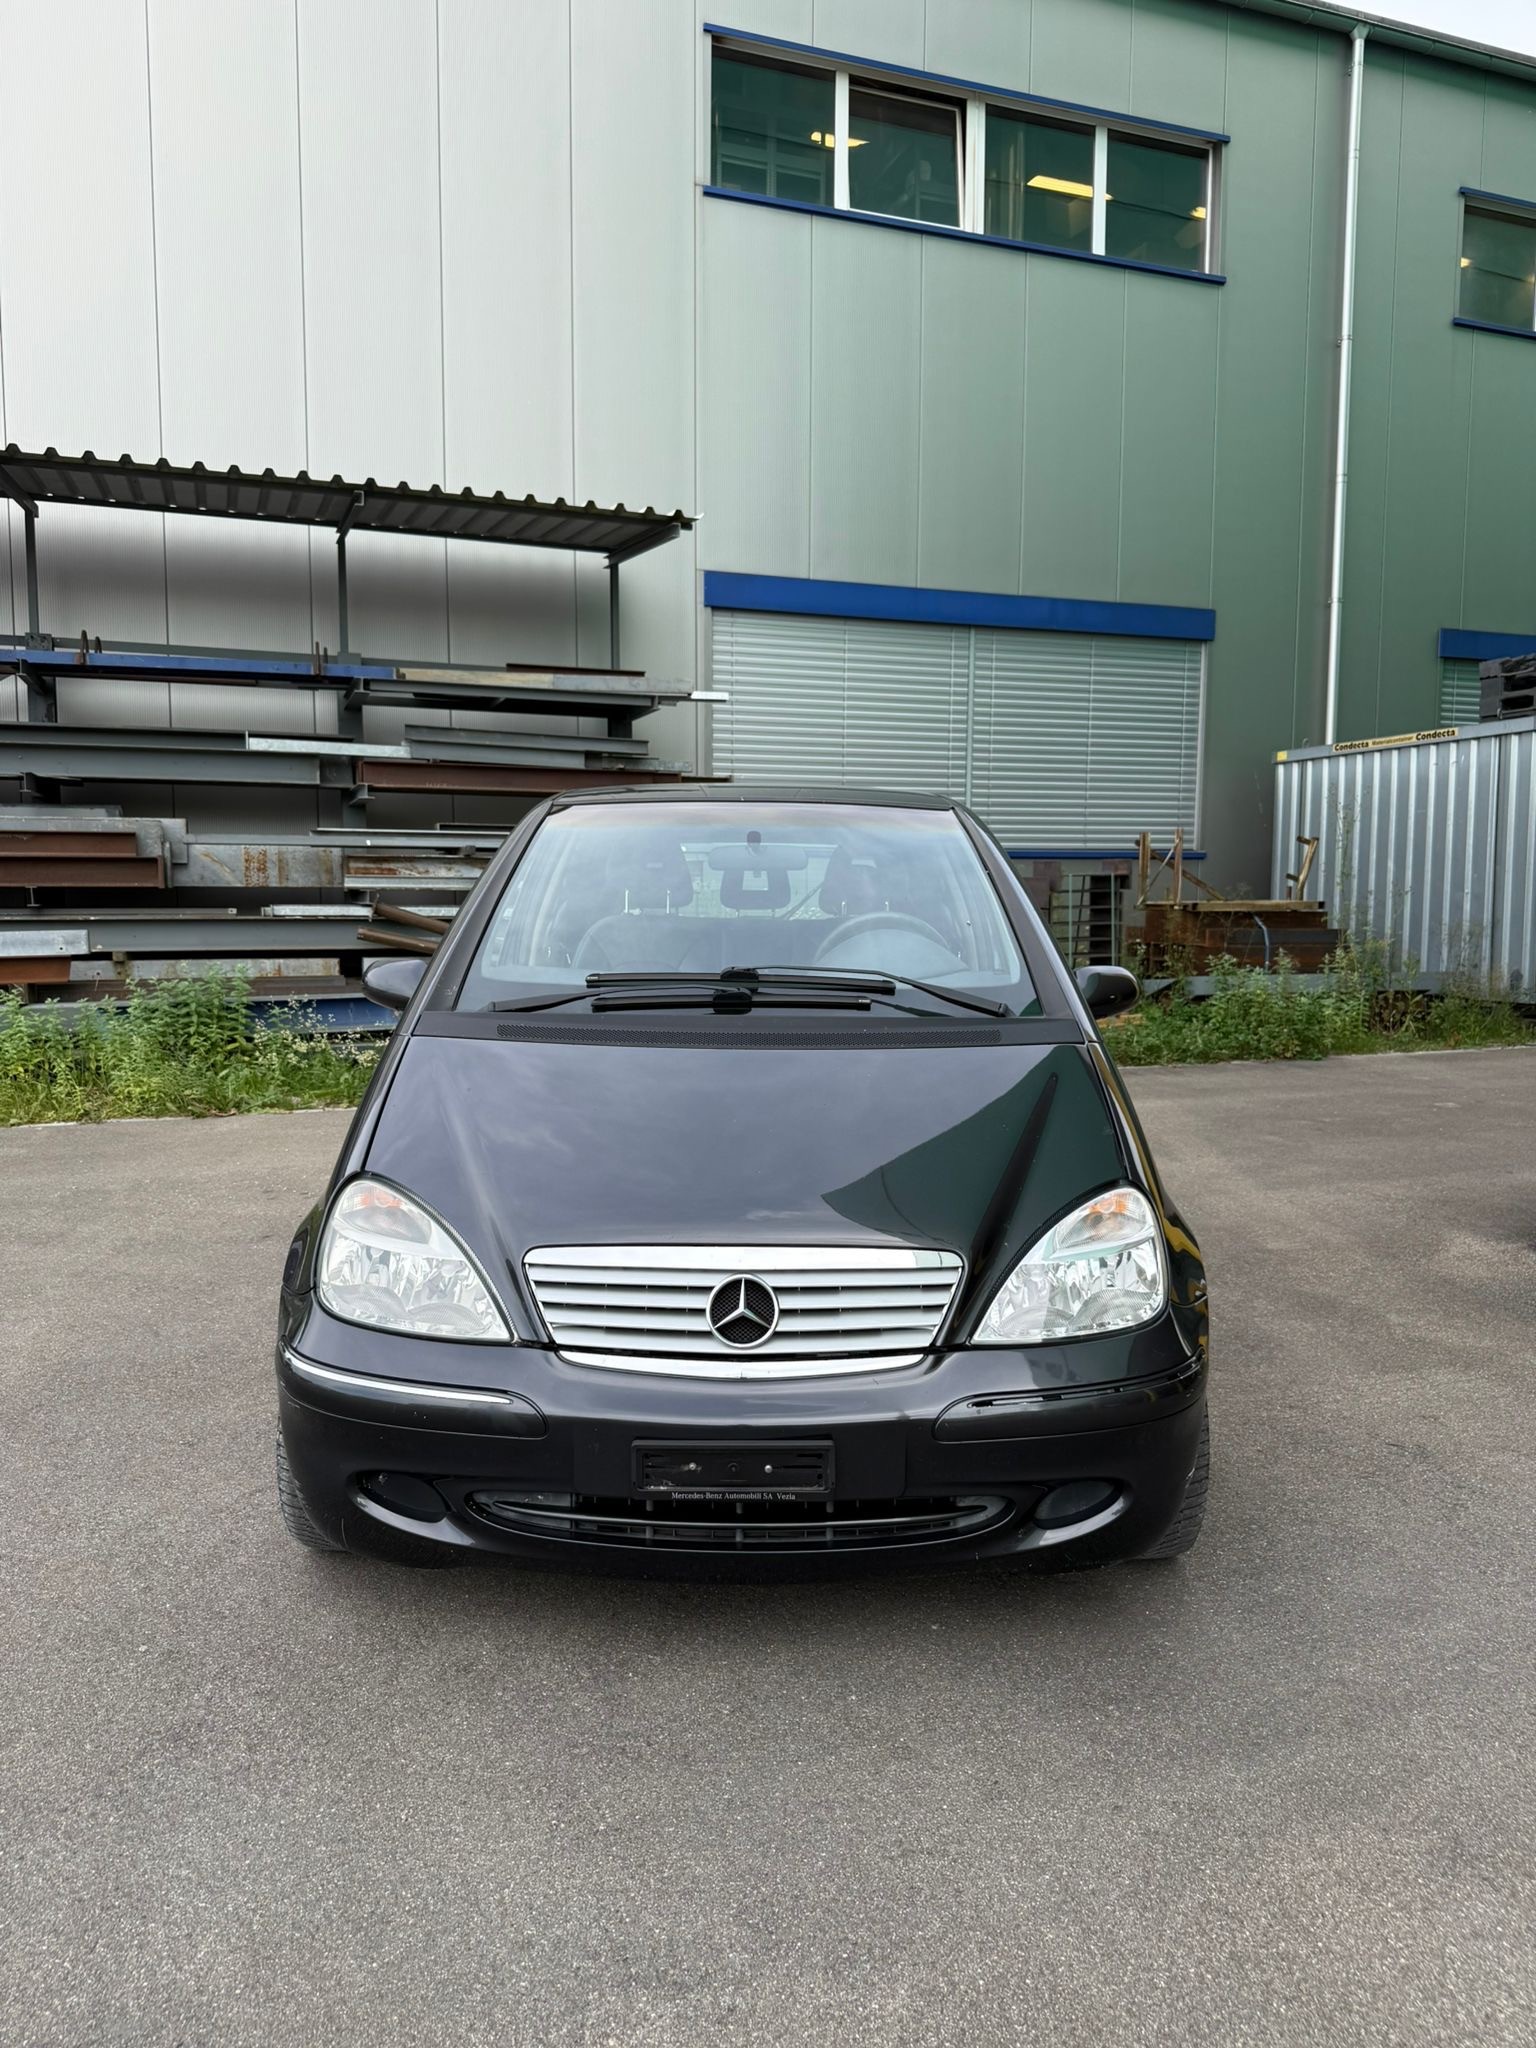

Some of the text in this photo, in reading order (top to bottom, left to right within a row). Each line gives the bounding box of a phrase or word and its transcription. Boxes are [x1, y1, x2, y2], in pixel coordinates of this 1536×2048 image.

[1334, 741, 1369, 752] Condecta
[1415, 729, 1456, 741] Condecta
[763, 1492, 773, 1500] SA
[776, 1492, 796, 1500] Vezia
